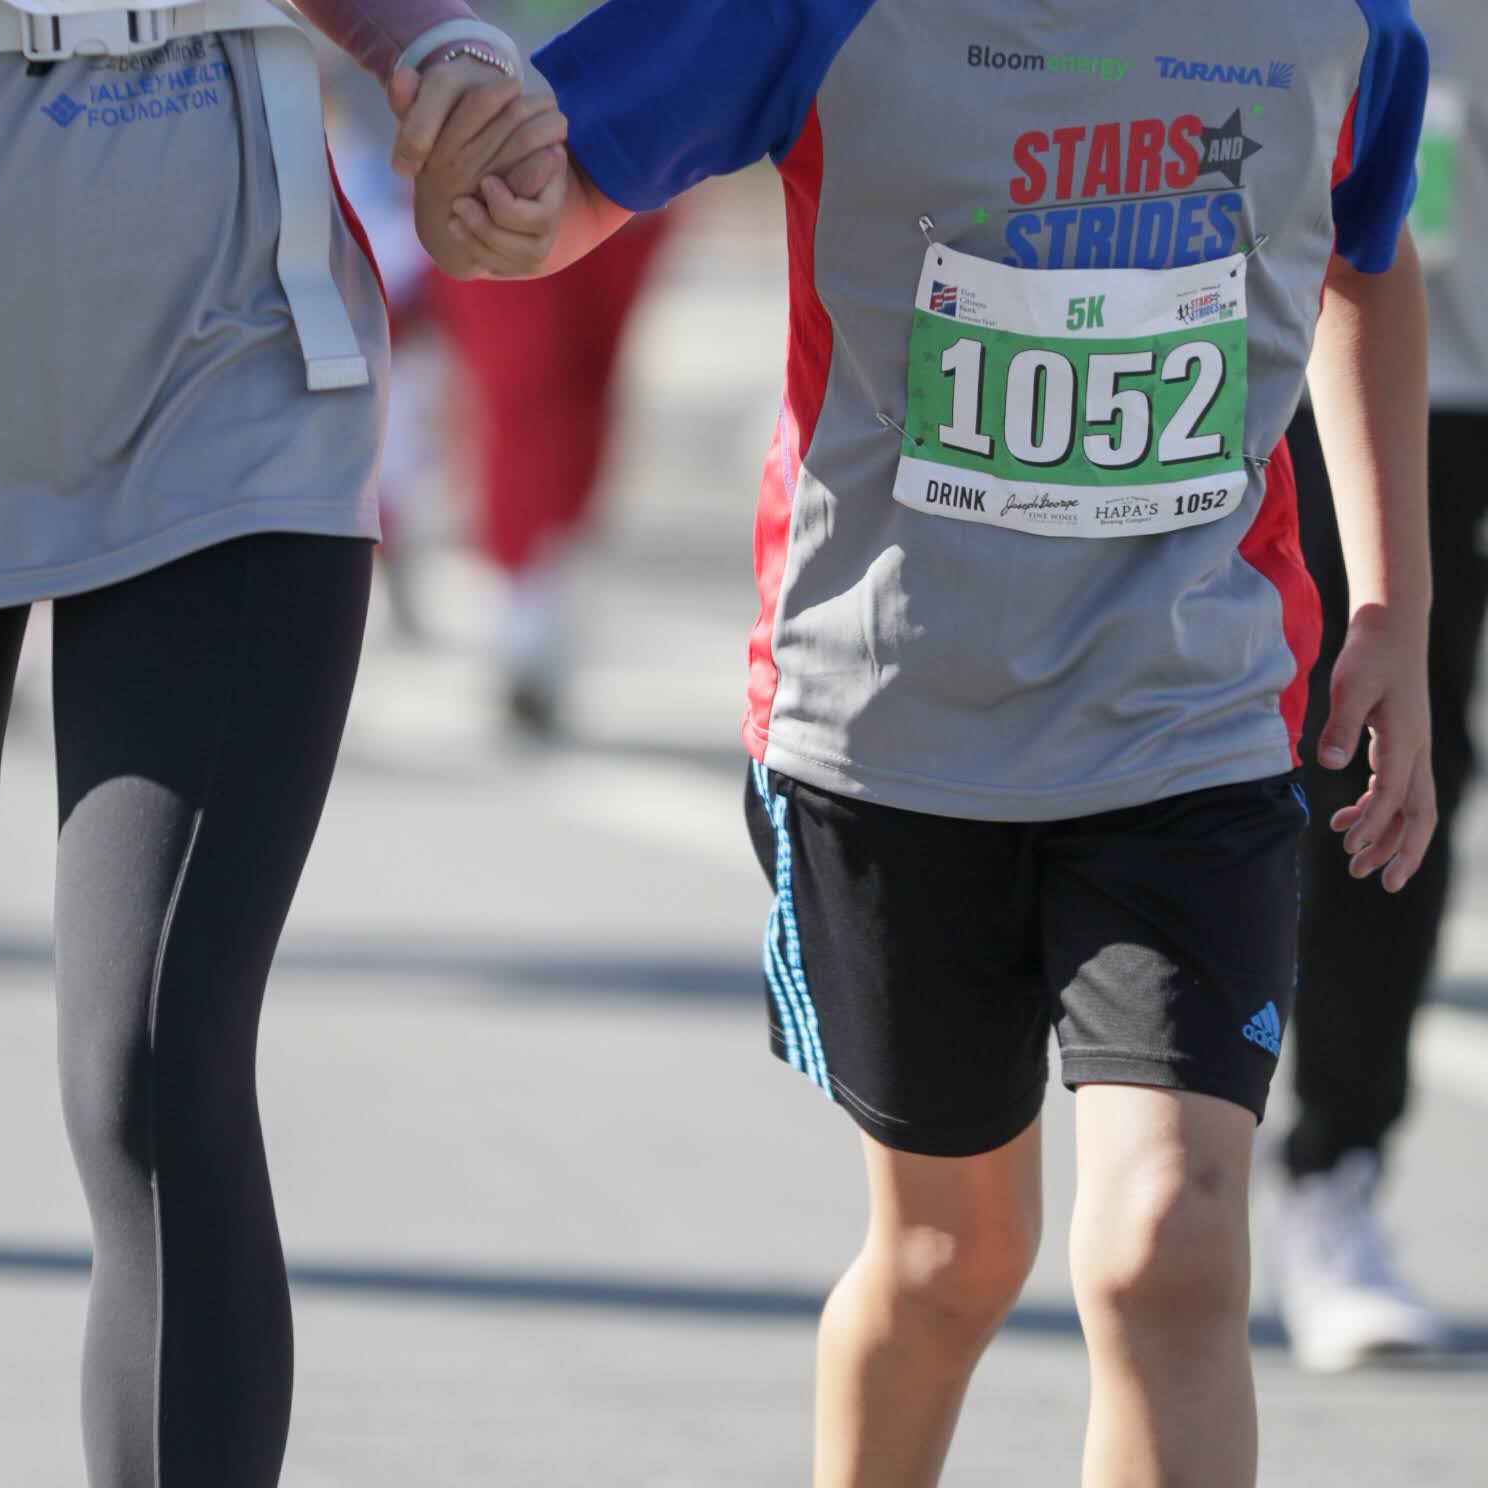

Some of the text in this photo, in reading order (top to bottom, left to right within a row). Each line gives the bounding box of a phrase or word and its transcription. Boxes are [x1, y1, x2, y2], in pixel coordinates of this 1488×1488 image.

[1155, 56, 1263, 87] TARANA
[1009, 114, 1204, 205] STARS
[1208, 136, 1244, 161] AND
[1066, 294, 1106, 331] 5K
[938, 337, 1226, 469] 1052
[925, 479, 987, 512] DRINK
[1095, 502, 1160, 519] HAPA'S
[1173, 488, 1229, 517] 1052
